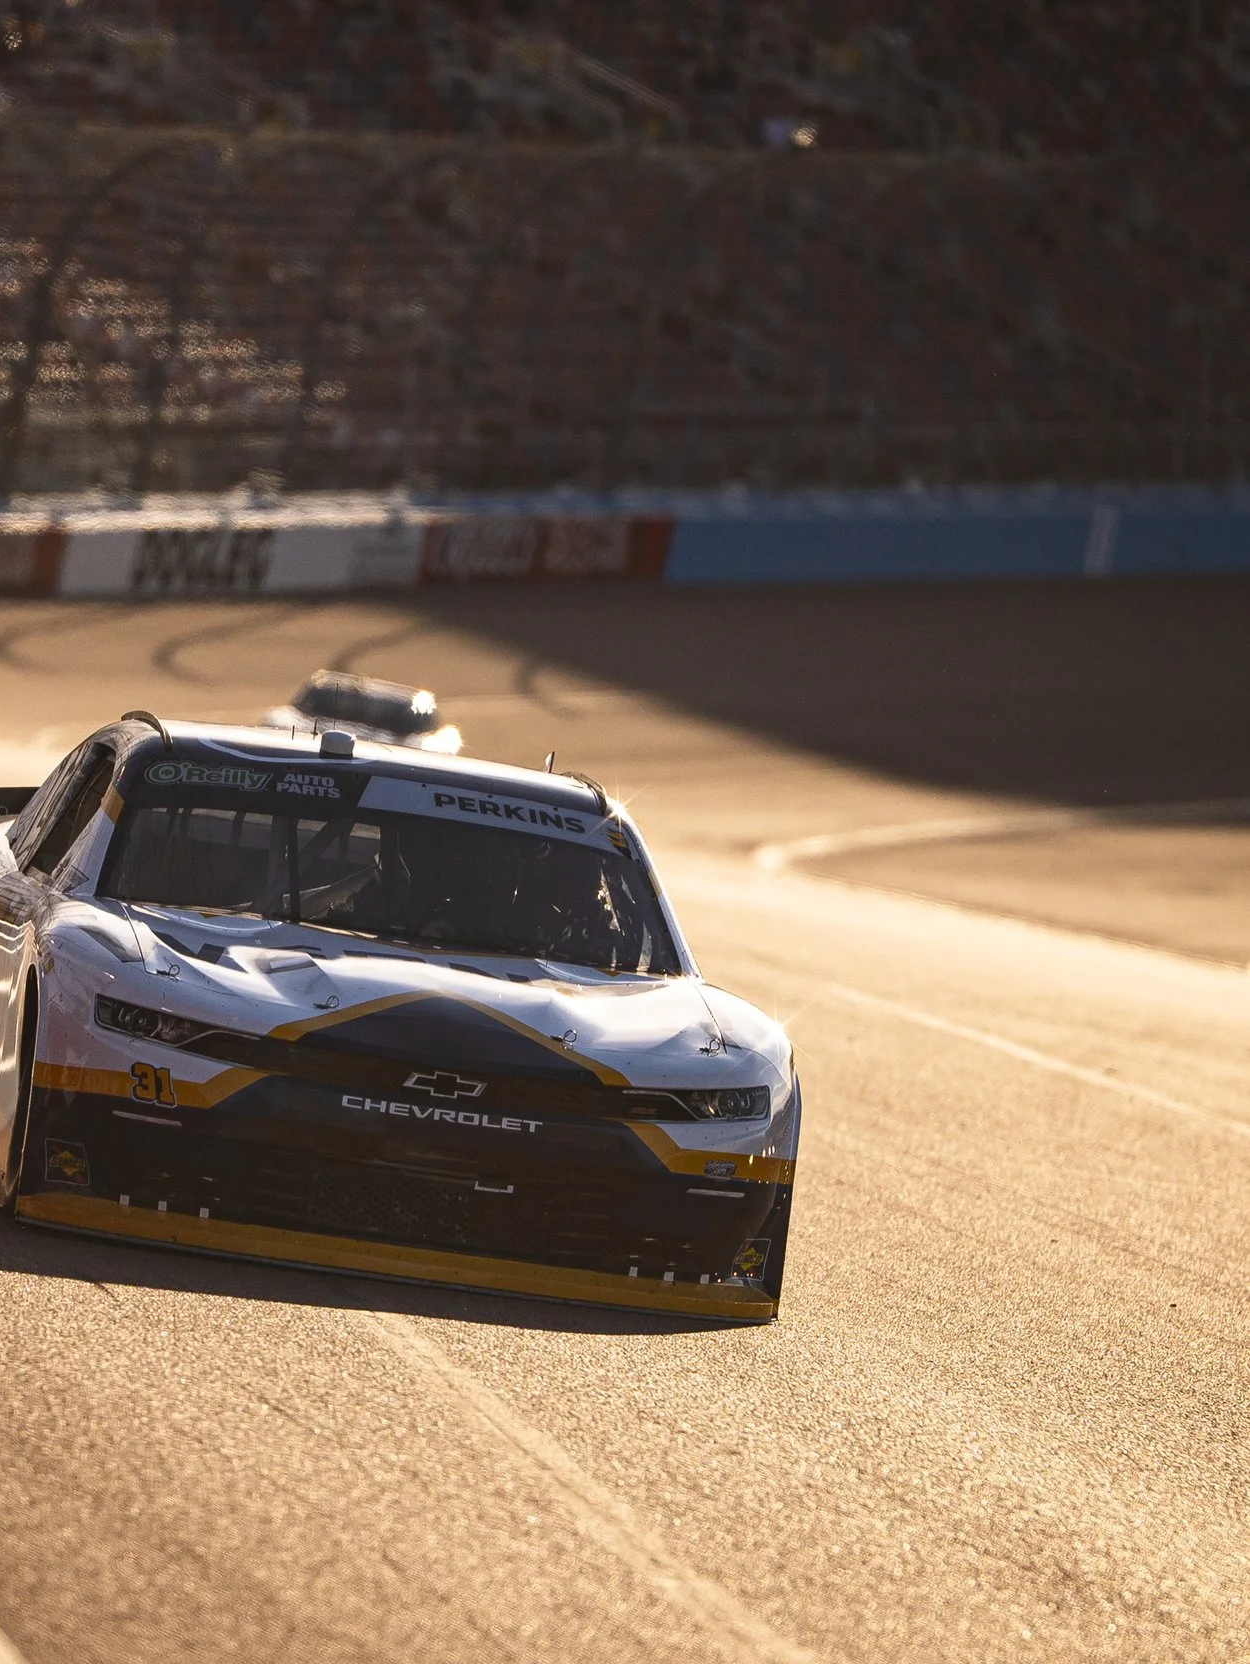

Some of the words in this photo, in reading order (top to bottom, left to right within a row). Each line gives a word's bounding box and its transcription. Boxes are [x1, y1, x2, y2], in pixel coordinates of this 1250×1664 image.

[146, 761, 271, 791] O'Reilly
[276, 782, 341, 799] PARTS
[283, 773, 335, 788] AUTO
[433, 792, 586, 834] PERKINS
[131, 1062, 177, 1108] 31
[341, 1094, 544, 1133] CHEVROLET
